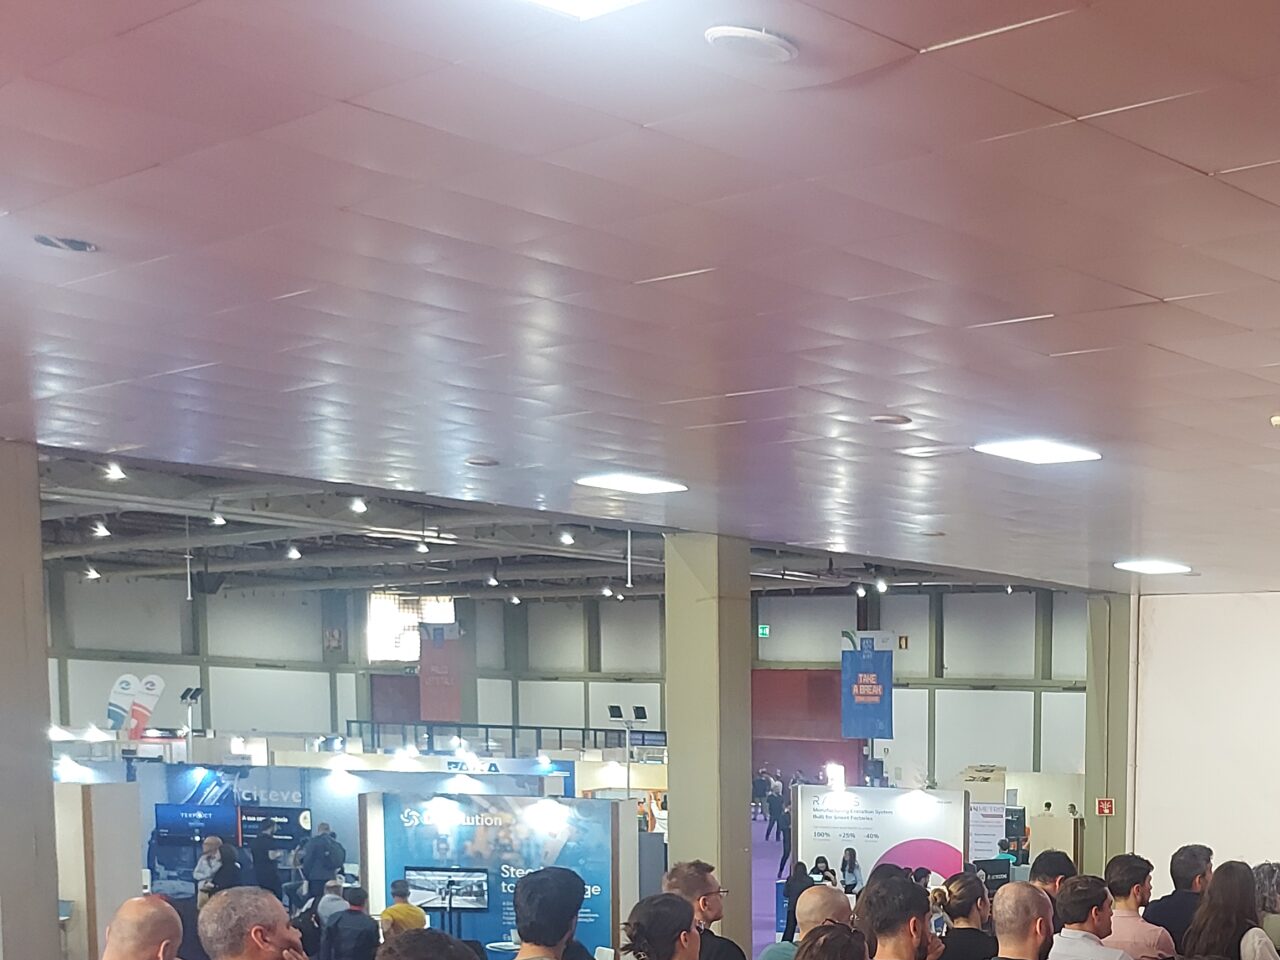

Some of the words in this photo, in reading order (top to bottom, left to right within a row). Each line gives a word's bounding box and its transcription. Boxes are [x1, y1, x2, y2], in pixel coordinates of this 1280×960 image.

[858, 673, 877, 684] TAKE
[860, 684, 883, 696] BREAK
[241, 787, 302, 802] citeve
